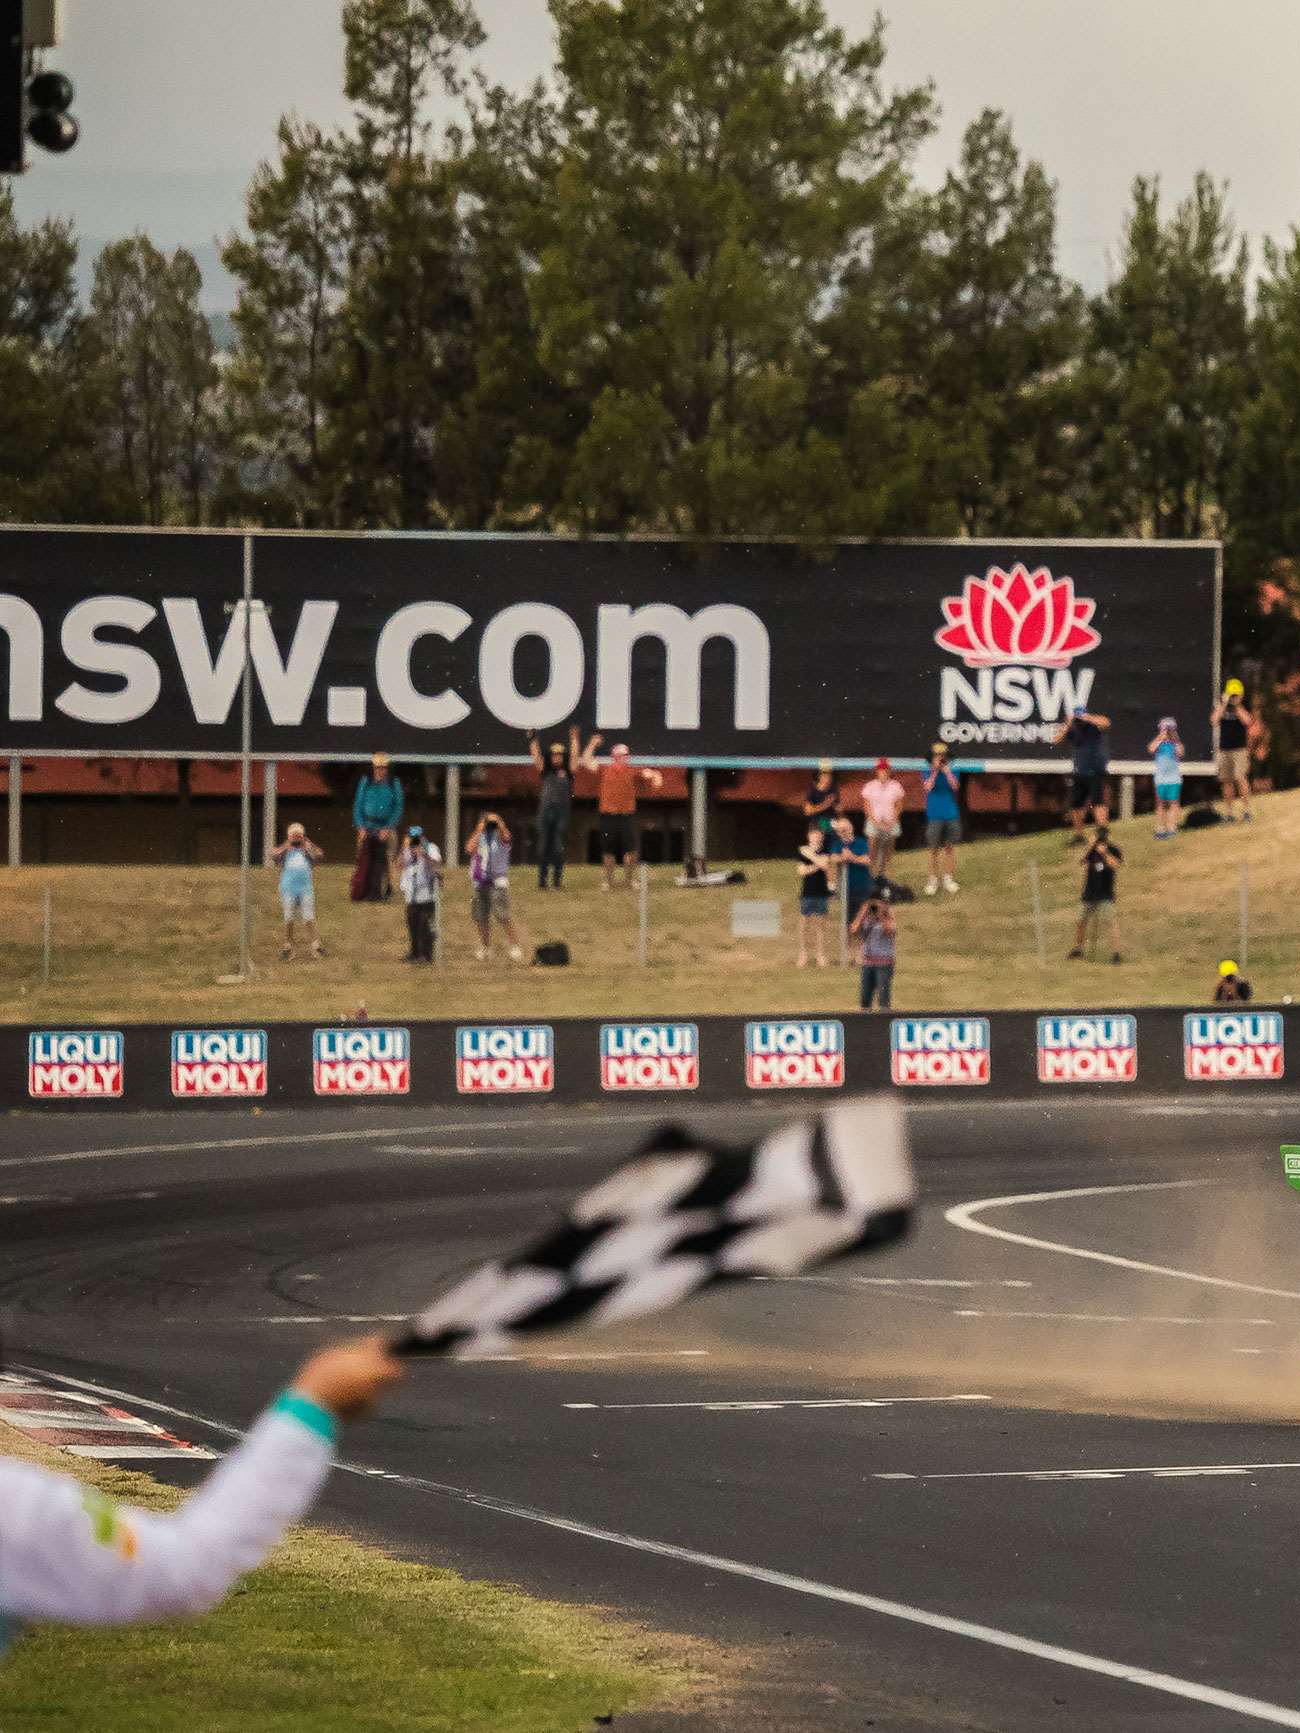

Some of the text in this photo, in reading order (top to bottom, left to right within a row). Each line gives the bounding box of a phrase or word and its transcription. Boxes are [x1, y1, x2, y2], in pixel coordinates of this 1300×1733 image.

[940, 666, 1095, 722] NSW
[463, 1030, 546, 1057] LIQUI
[607, 1028, 691, 1055] LIQUI
[752, 1025, 837, 1053] LIQUI
[899, 1022, 983, 1049] LIQUI
[1044, 1020, 1129, 1047] LIQUI
[1191, 1017, 1276, 1045] LIQUI
[35, 1036, 118, 1062] LIQUI
[178, 1035, 261, 1062] LIQUI
[320, 1034, 403, 1061] LIQUI
[1191, 1046, 1281, 1076] MOLY
[178, 1063, 263, 1092] MOLY
[320, 1062, 406, 1091] MOLY
[463, 1059, 549, 1087] MOLY
[607, 1057, 694, 1086] MOLY
[752, 1055, 840, 1083] MOLY
[899, 1051, 986, 1080] MOLY
[1045, 1049, 1134, 1078] MOLY
[35, 1064, 120, 1092] MOLY
